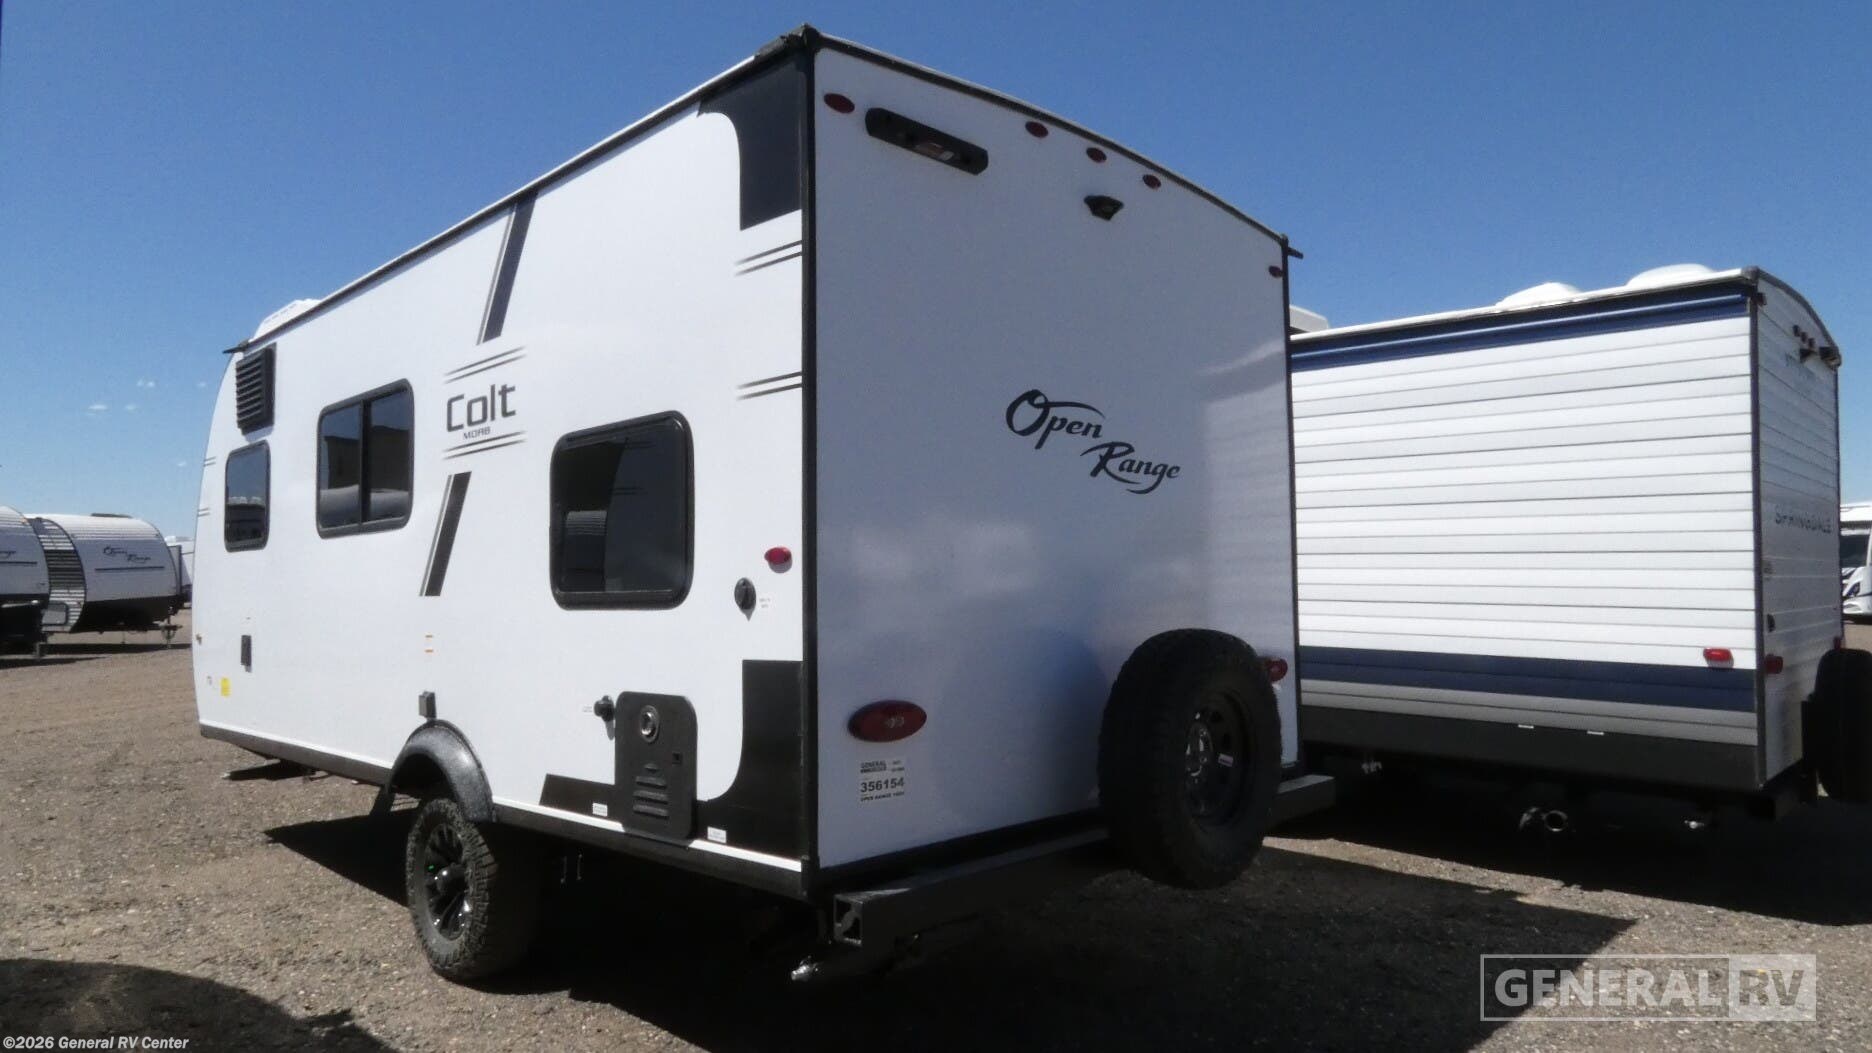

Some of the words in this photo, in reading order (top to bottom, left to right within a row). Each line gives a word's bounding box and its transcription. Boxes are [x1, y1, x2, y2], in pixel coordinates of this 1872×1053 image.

[446, 383, 517, 432] Colt
[1005, 389, 1107, 450] Open
[1079, 441, 1181, 495] Range
[860, 777, 904, 793] 356154
